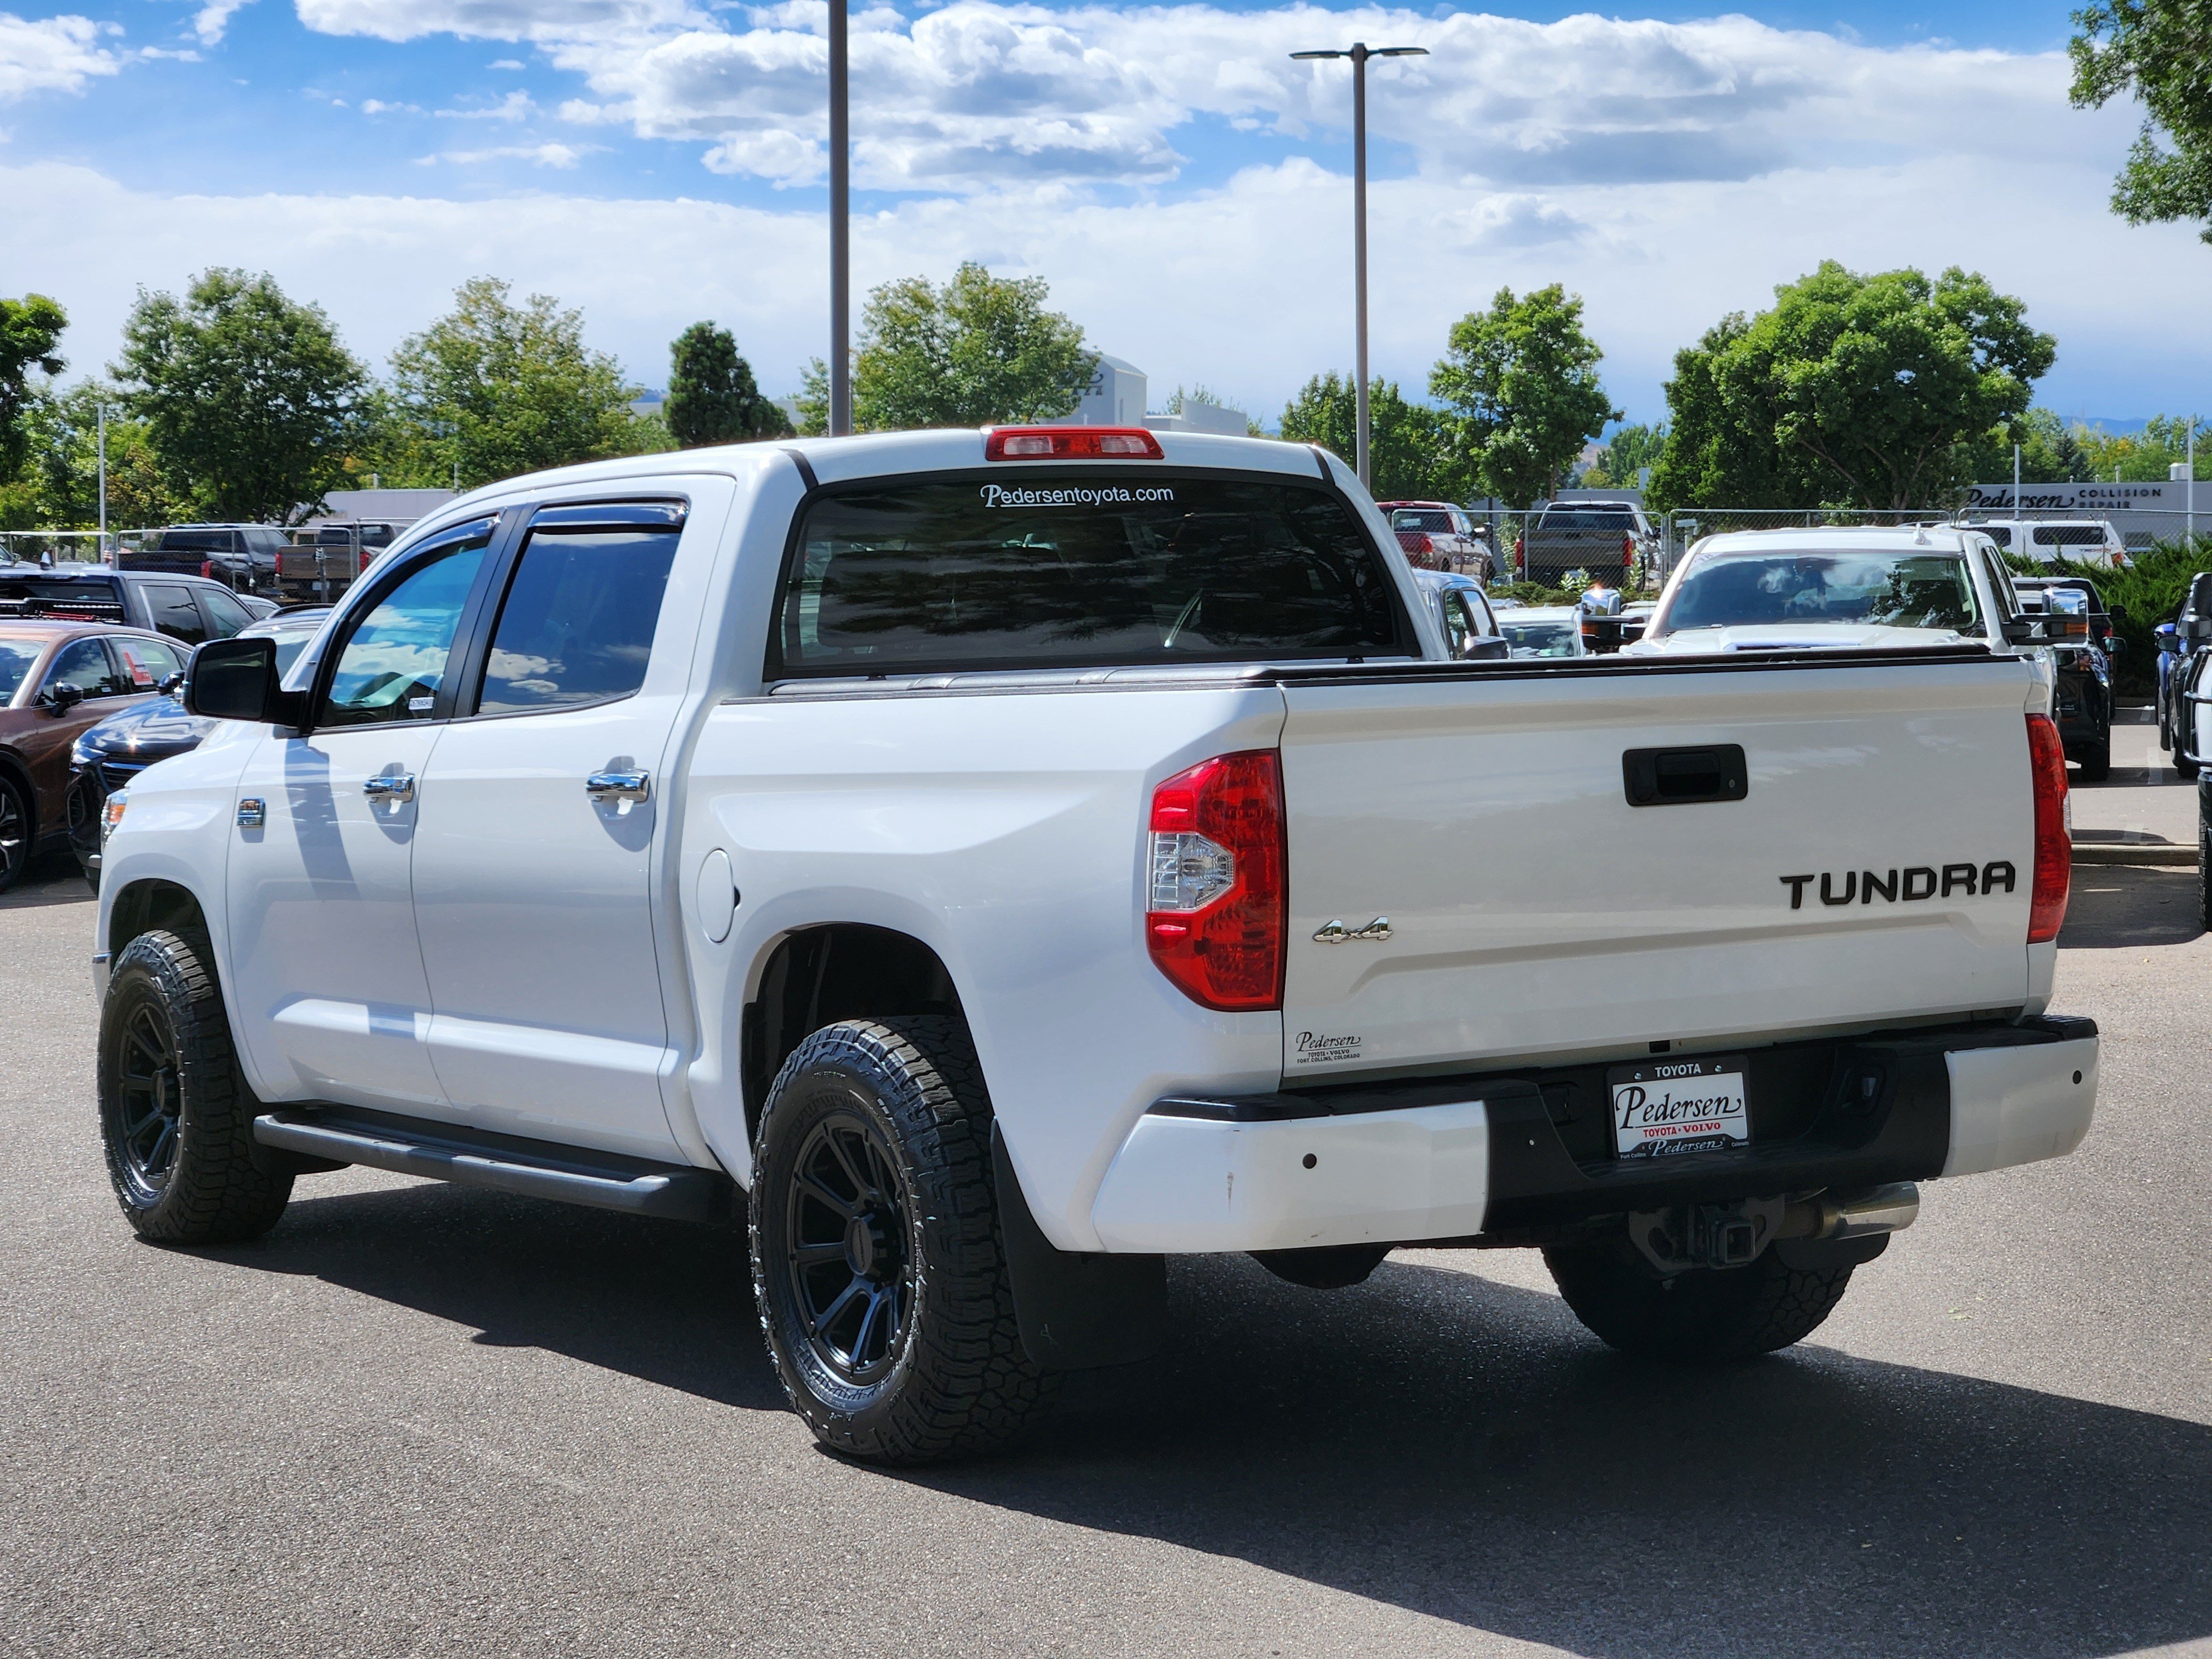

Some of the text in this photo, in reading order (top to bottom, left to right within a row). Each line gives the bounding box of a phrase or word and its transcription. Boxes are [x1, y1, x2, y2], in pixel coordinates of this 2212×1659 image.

[980, 484, 1174, 508] Pedersentoyota.com
[1968, 488, 2162, 508] Pedersen COLLISION
[2079, 501, 2131, 509] REPAIR
[1780, 860, 2016, 909] TUNDRA
[1313, 916, 1394, 943] 4x4
[1296, 1031, 1361, 1052] Pedersen
[1655, 1063, 1702, 1078] TOYOTA
[1615, 1086, 1742, 1130] Pedersen
[1644, 1122, 1721, 1138] TOYOTA VOLVO
[1648, 1139, 1724, 1156] Pedersen
